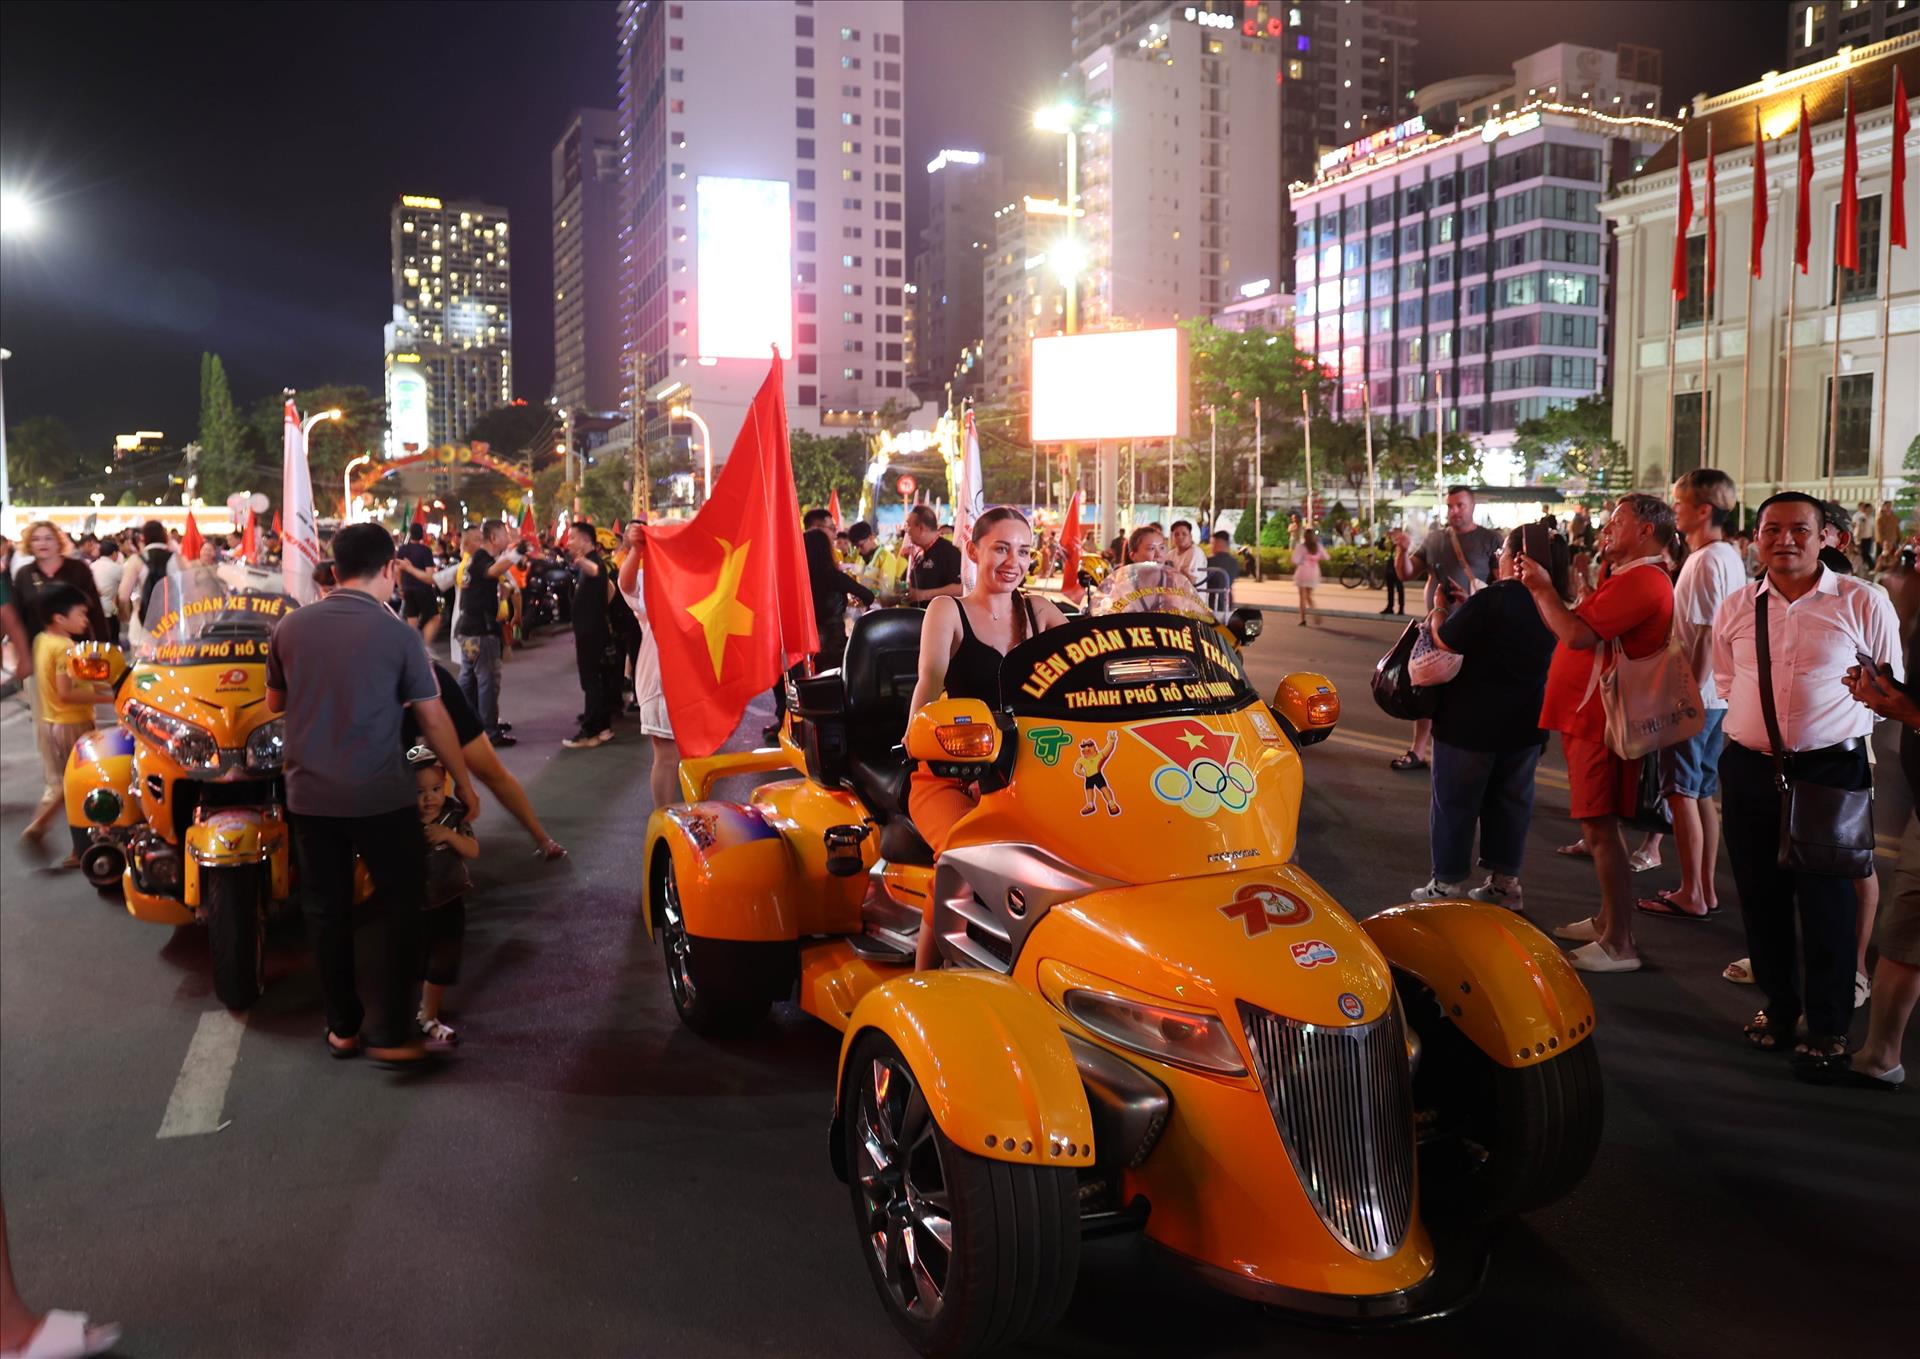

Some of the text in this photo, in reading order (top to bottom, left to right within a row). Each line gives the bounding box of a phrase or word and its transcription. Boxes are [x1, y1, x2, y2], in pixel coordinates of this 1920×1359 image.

[228, 596, 247, 610] XE
[1022, 653, 1070, 698] LIÊN
[1065, 630, 1125, 664] ĐOÀN
[1125, 627, 1156, 648] XE
[1065, 686, 1121, 709] THÀNH
[1123, 683, 1158, 704] PHỐ
[1183, 681, 1207, 700] CHÍ
[1207, 681, 1235, 698] MINH
